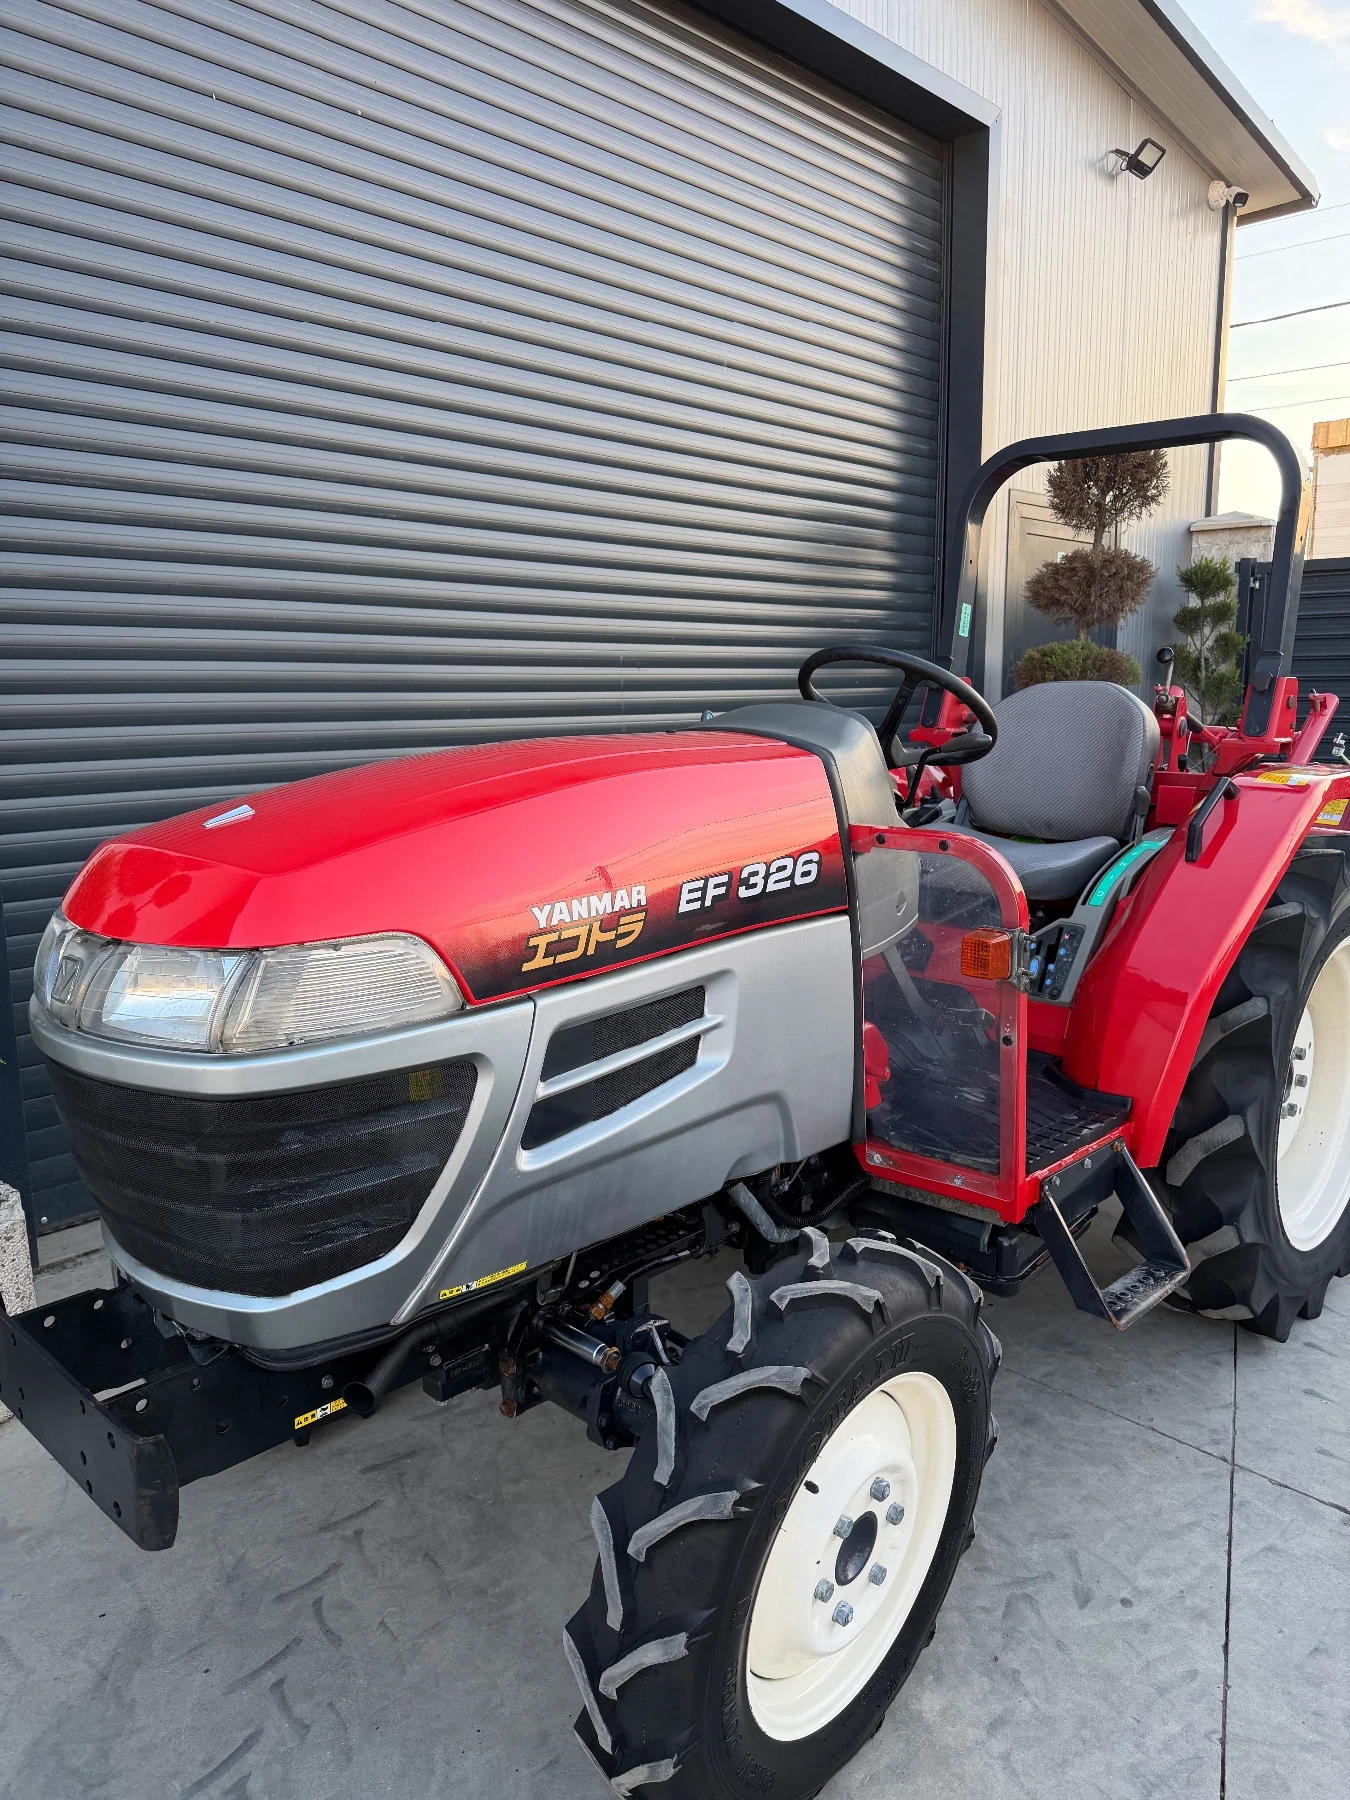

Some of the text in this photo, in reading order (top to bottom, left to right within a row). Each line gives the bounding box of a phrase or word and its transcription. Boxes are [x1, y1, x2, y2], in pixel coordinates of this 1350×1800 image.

[530, 884, 647, 929] YANMAR
[678, 851, 820, 914] EF 326
[521, 911, 647, 972] エコトラ
